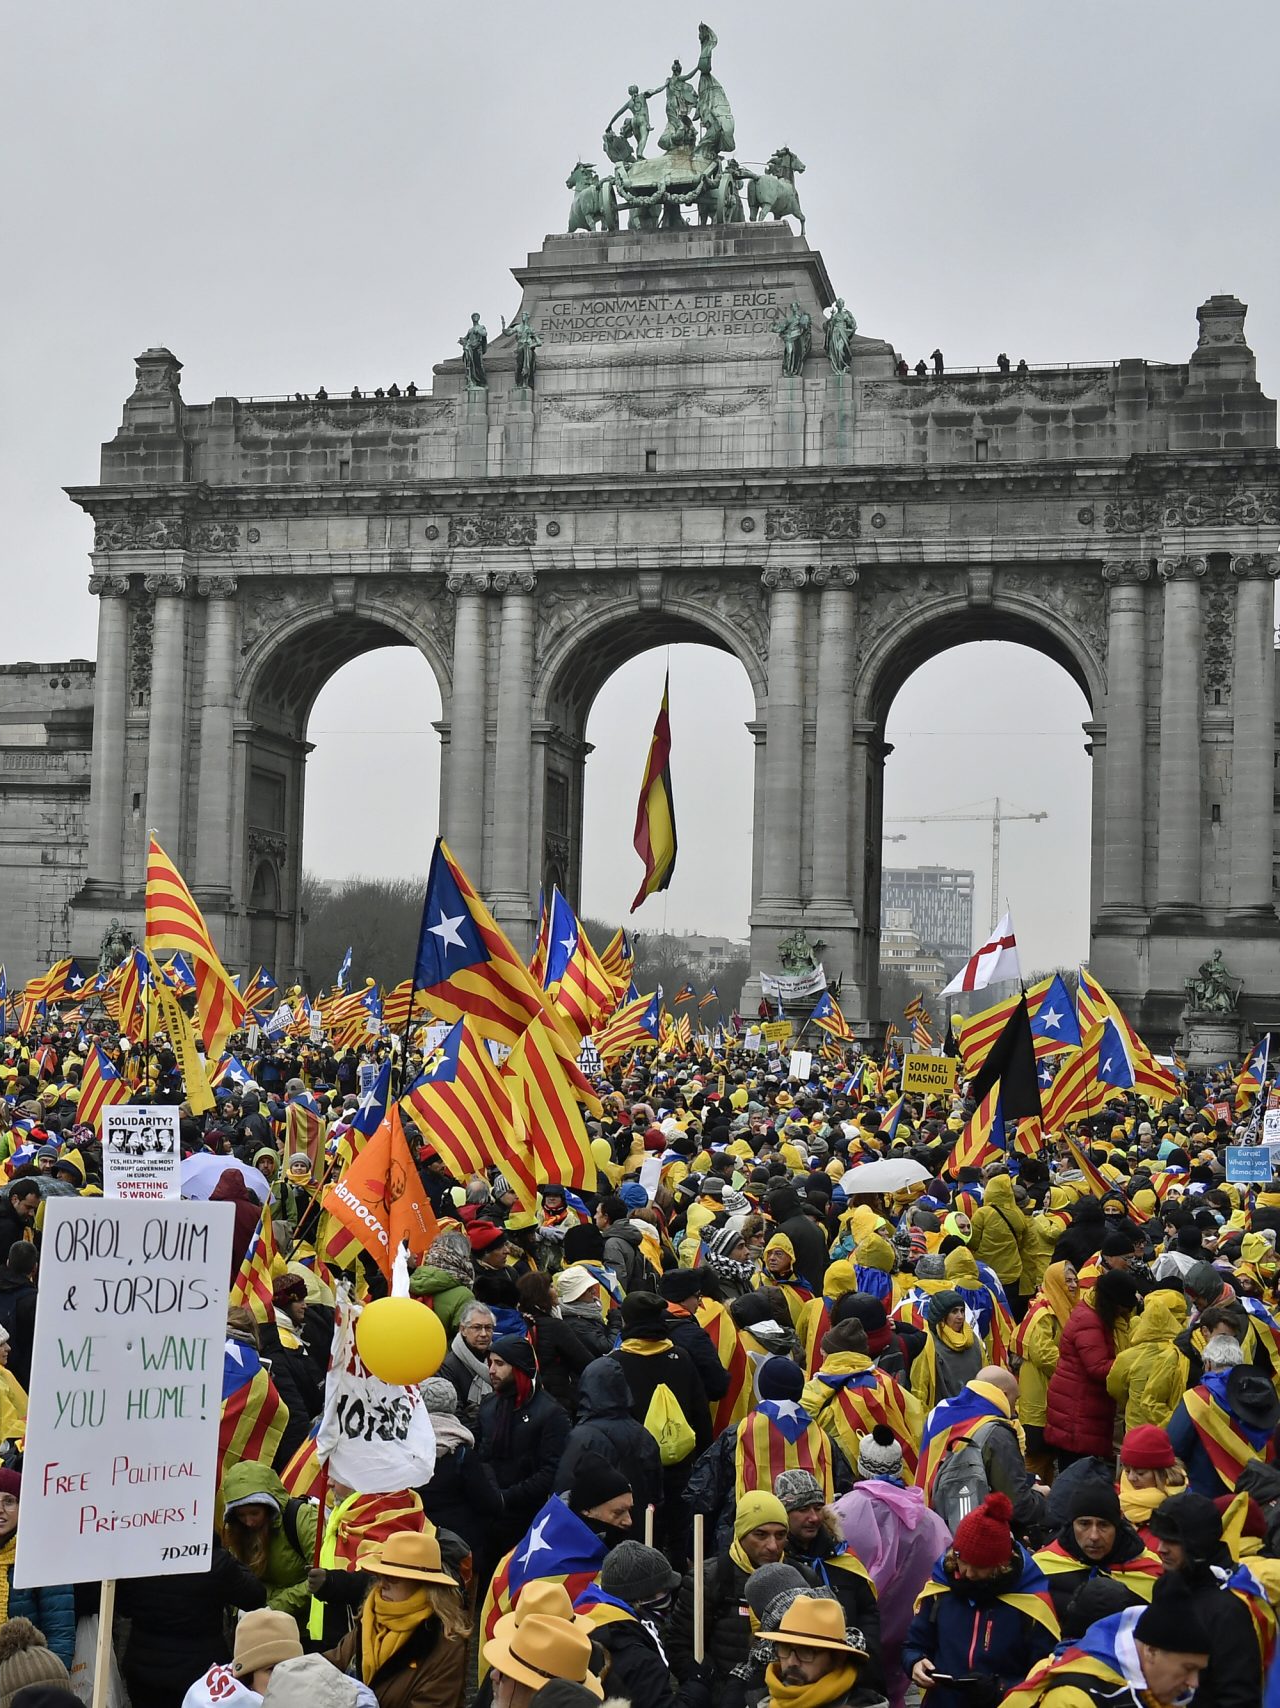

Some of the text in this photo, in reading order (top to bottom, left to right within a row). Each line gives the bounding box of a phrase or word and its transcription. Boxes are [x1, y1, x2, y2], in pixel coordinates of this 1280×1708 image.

[552, 303, 571, 315] CE
[673, 298, 686, 310] A
[694, 295, 723, 309] ETE
[732, 292, 777, 307] ERIGE
[671, 326, 691, 338] DE
[697, 324, 717, 337] LA
[723, 321, 776, 335] BELGI
[168, 1001, 180, 1035] INDEP
[909, 1061, 948, 1074] SOM DEL
[907, 1073, 948, 1085] MASNOU
[108, 1117, 173, 1126] SOLIDARITY?
[1254, 1159, 1269, 1167] your
[116, 1181, 169, 1190] SOMETHING
[119, 1191, 166, 1199] IS WRONG.
[334, 1179, 389, 1247] democra
[54, 1213, 210, 1266] ORIOL, QUIM
[62, 1275, 219, 1315] & JORDIS:
[57, 1335, 212, 1373] WE WANT
[54, 1388, 107, 1430] YOU
[159, 1542, 209, 1562] 7D2017
